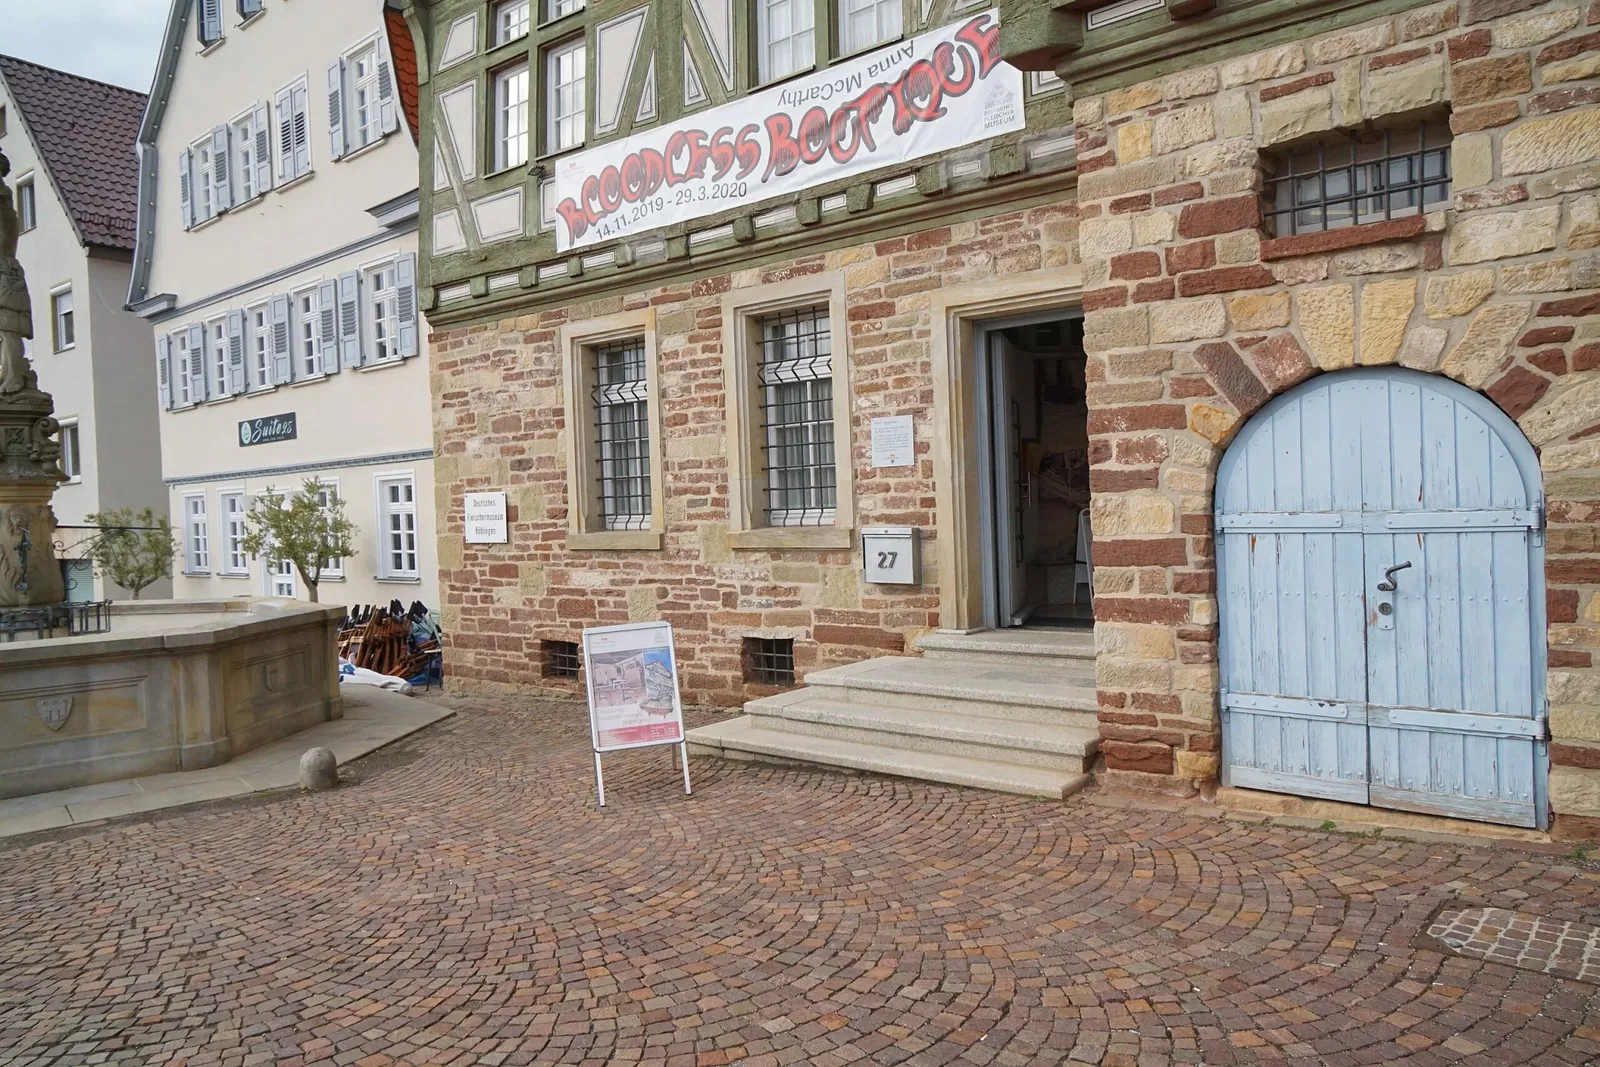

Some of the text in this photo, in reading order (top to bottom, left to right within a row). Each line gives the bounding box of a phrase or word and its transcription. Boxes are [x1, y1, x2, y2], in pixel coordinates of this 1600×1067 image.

[777, 40, 914, 107] Anna McCarthy
[984, 103, 1014, 116] DEUTSCHES
[984, 109, 1015, 122] FLEISCHER
[984, 115, 1015, 129] MUSEUM
[596, 197, 664, 240] 14.11.2019
[675, 181, 747, 206] 29.3.2020
[473, 499, 496, 507] Deutsches
[475, 526, 496, 536] Böblingen
[877, 551, 898, 569] 27
